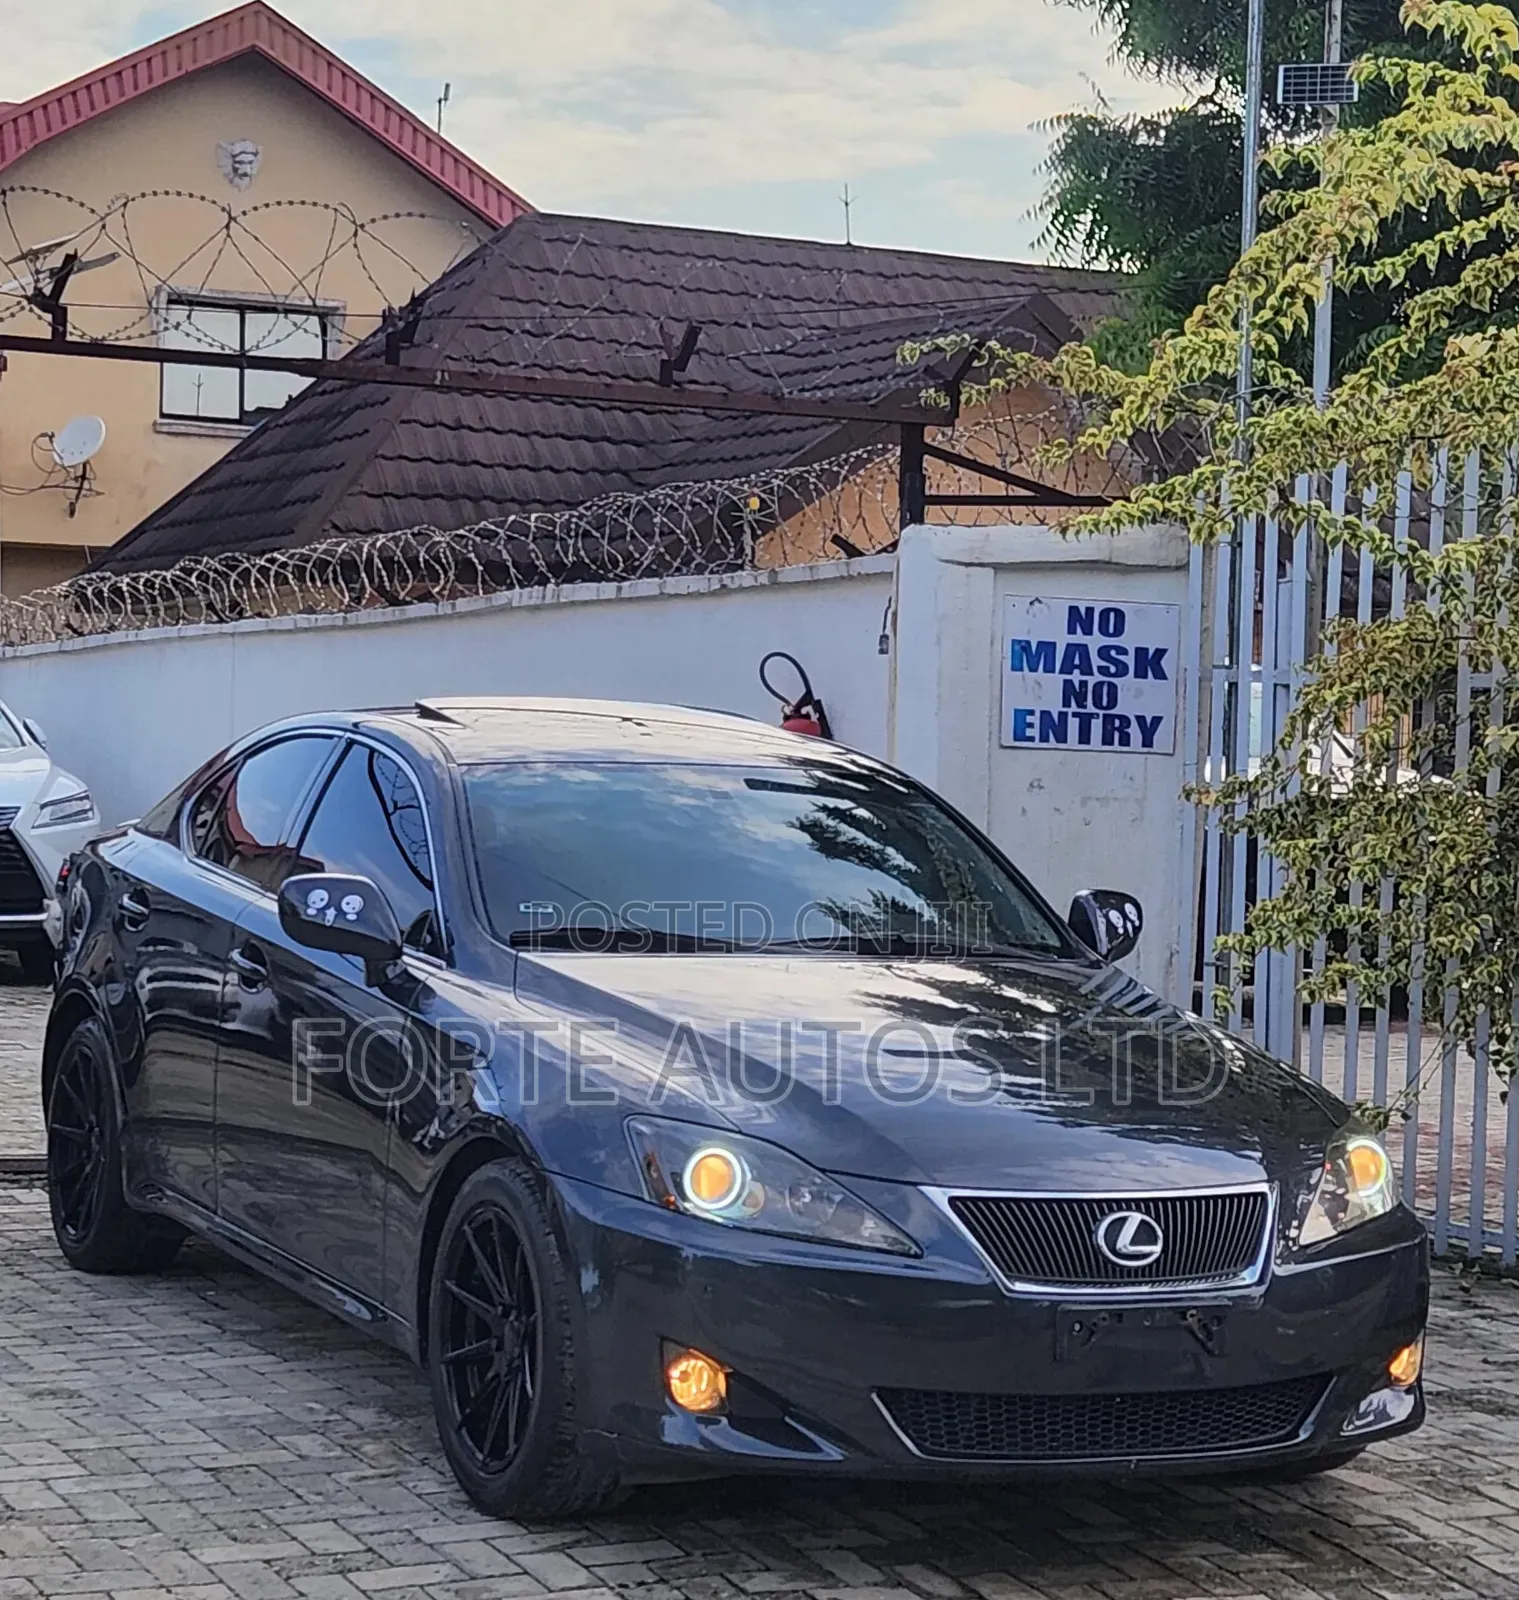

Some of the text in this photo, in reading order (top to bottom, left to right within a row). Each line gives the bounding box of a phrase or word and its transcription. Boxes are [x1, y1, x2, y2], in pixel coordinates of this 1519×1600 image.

[1066, 605, 1126, 638] NO
[1011, 639, 1169, 680] MASK
[1061, 679, 1119, 711] NO
[1013, 708, 1164, 748] ENTRY
